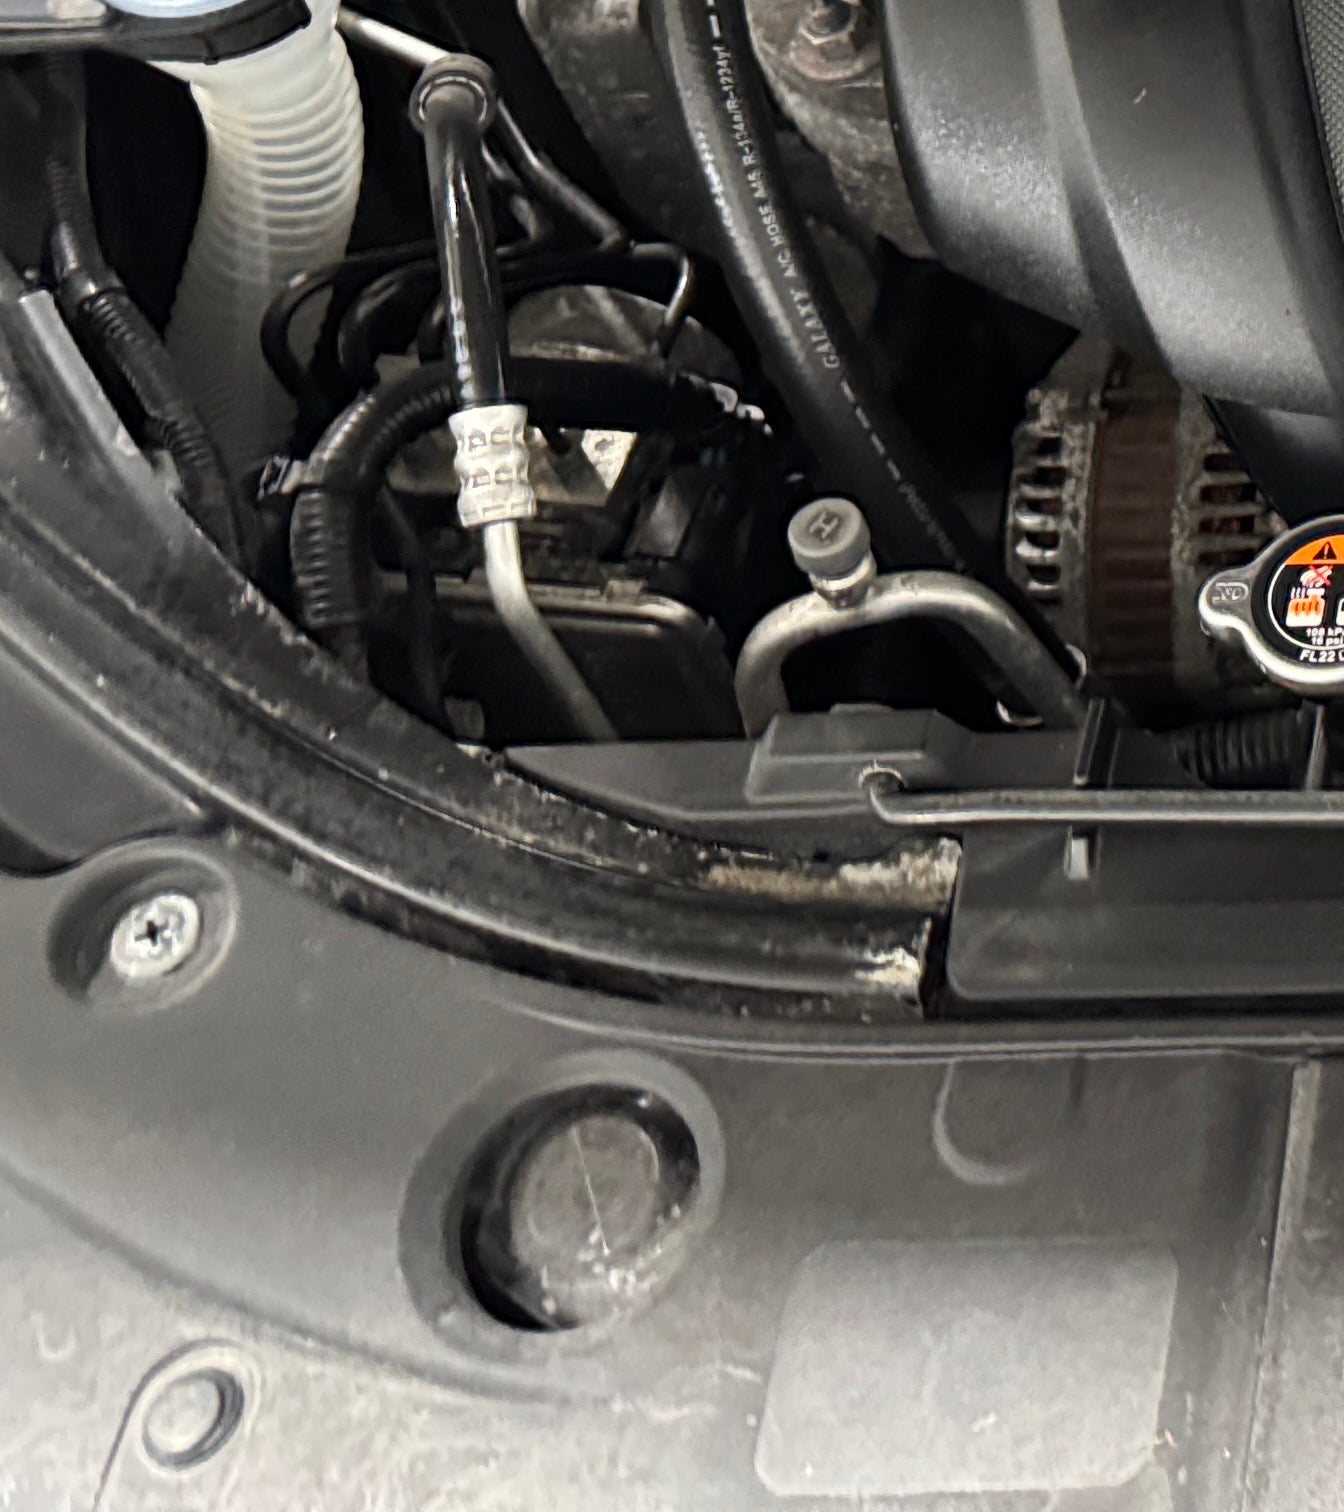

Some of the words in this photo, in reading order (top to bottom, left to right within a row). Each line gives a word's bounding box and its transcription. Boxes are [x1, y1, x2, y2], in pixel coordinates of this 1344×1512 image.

[759, 205, 783, 246] HOSE
[791, 288, 839, 368] GALAXY
[1325, 635, 1344, 647] psi
[1299, 648, 1336, 663] FL22
